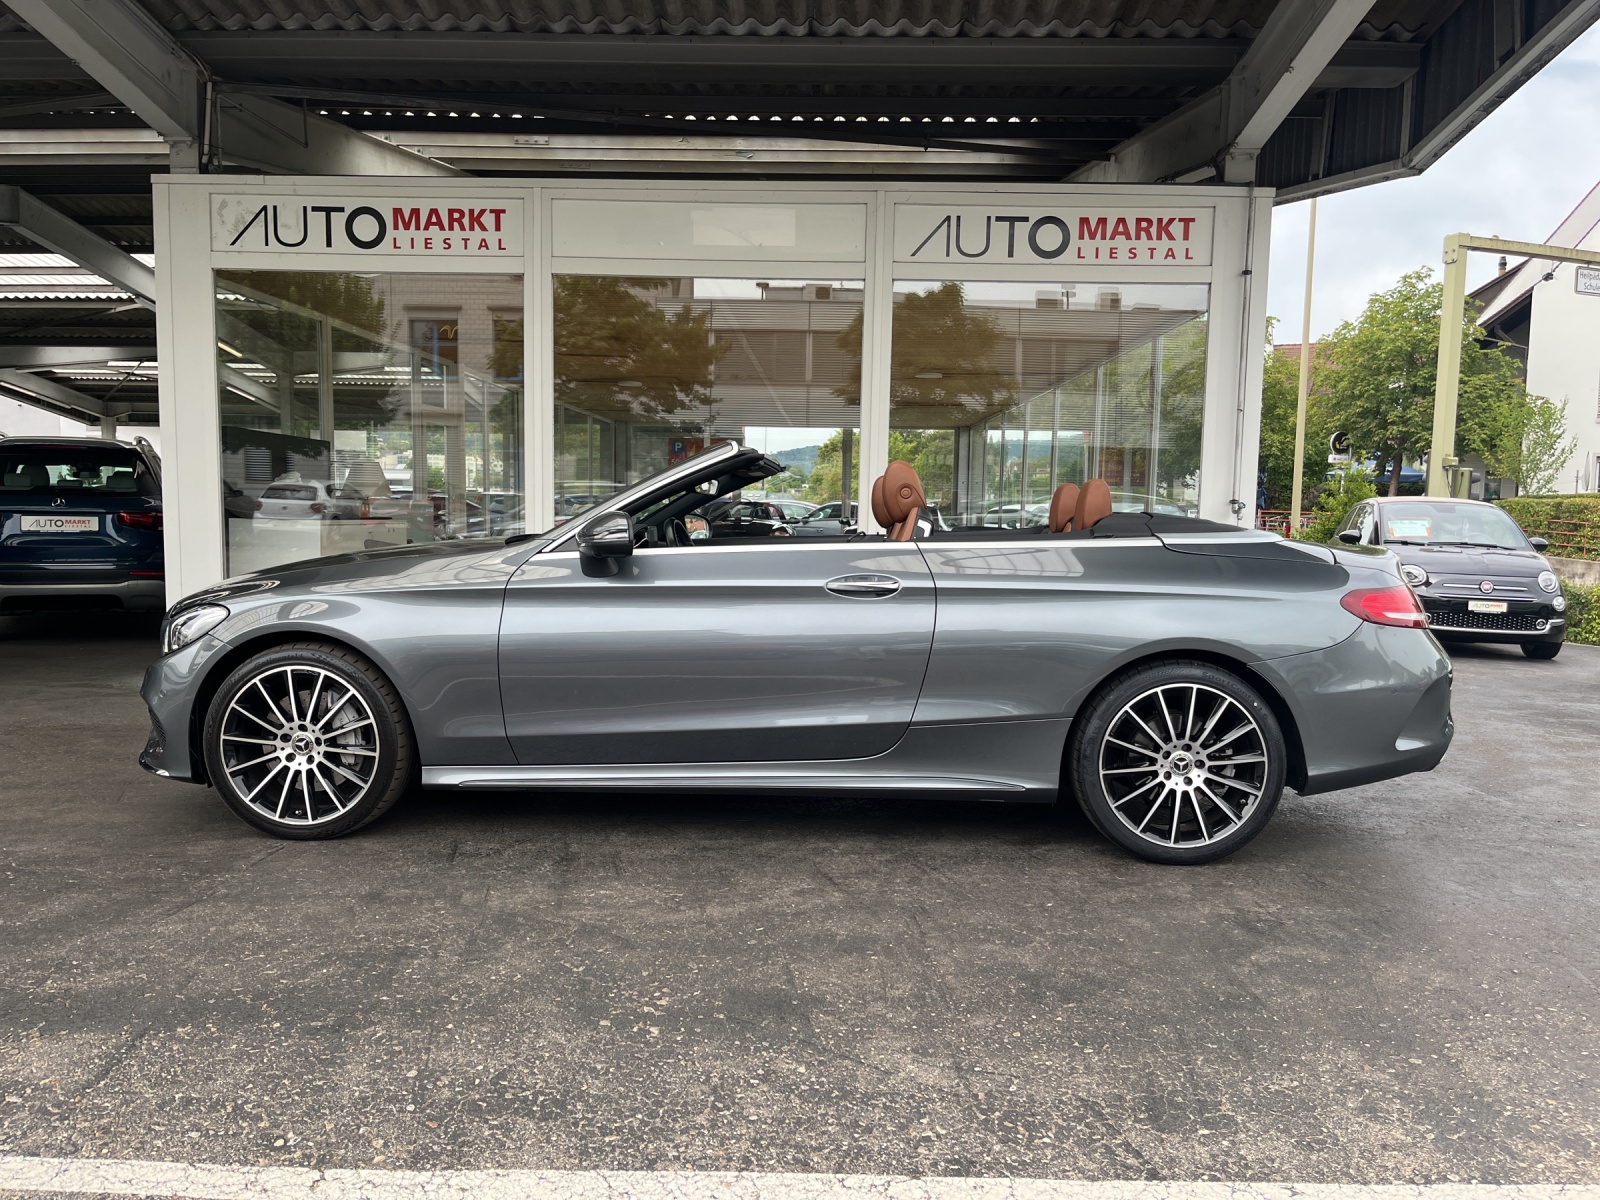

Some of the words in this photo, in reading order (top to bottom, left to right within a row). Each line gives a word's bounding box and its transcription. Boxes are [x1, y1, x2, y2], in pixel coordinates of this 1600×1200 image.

[229, 204, 387, 250] AUTO
[392, 207, 507, 232] MARKT
[392, 236, 507, 251] LIESTAL
[910, 214, 1071, 260] AUTO
[1077, 216, 1196, 242] MARKT
[1076, 246, 1194, 261] LIESTAL
[29, 518, 64, 528] AUTO
